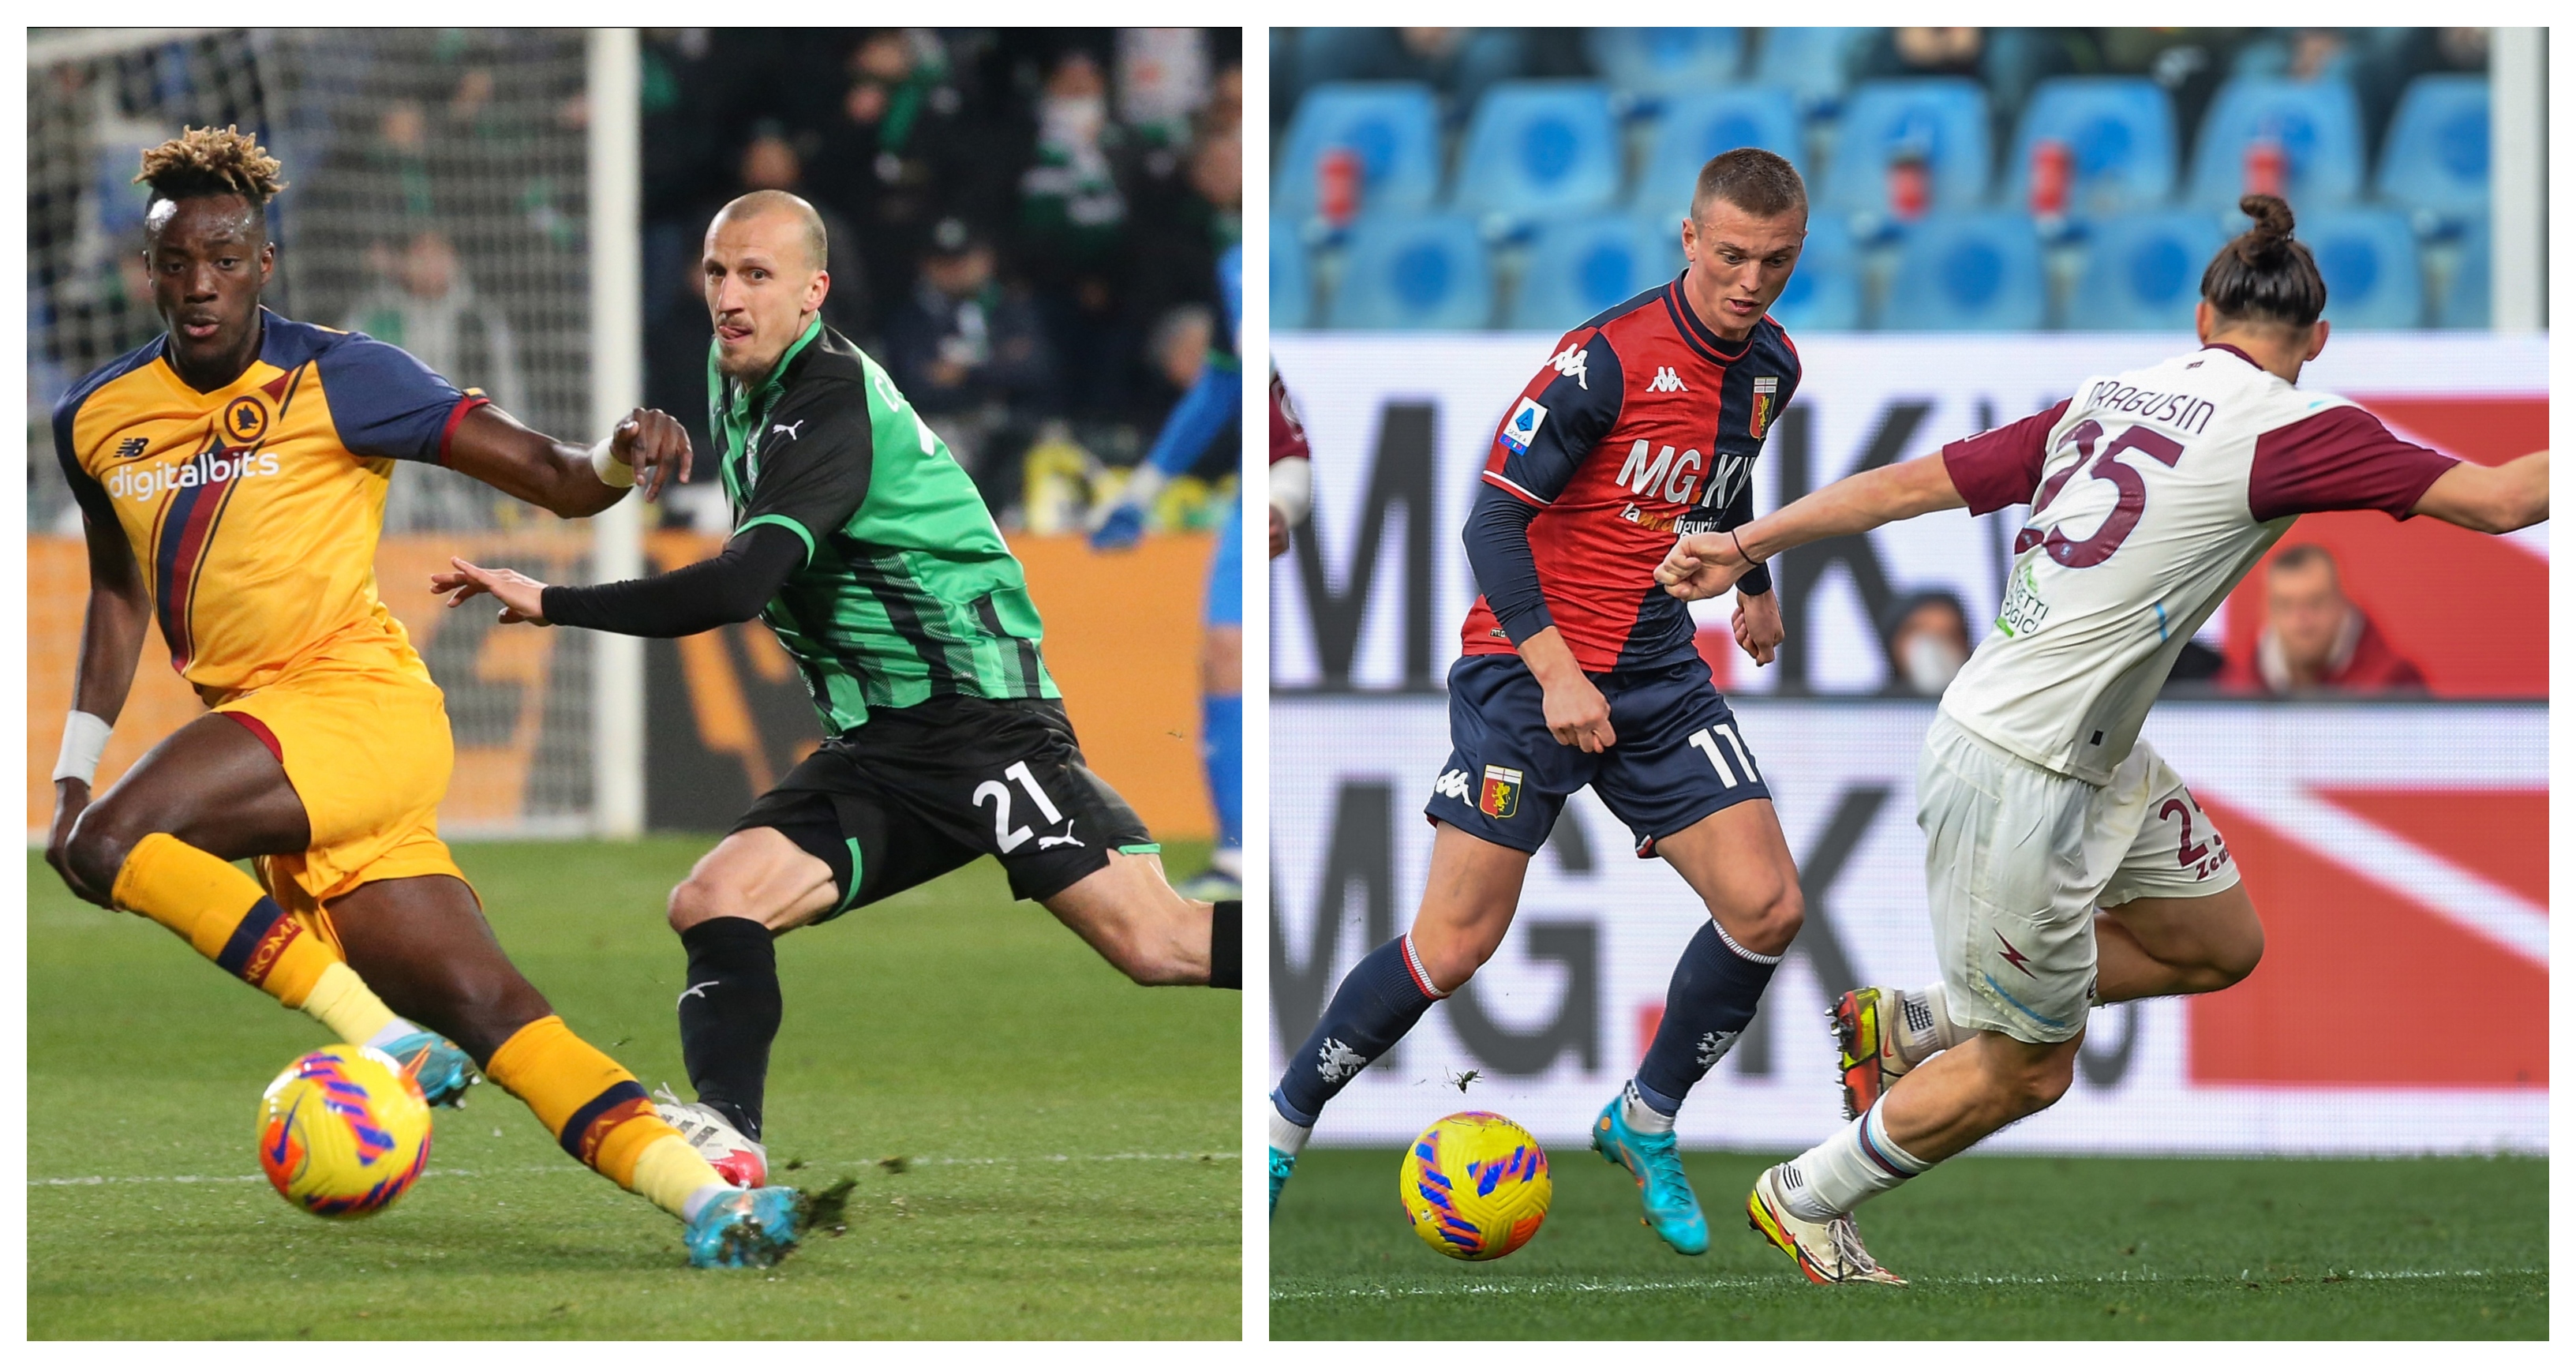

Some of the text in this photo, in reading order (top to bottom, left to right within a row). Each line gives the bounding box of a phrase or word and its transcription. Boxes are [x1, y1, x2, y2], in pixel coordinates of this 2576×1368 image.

[109, 452, 280, 502] digitalbits
[2015, 419, 2185, 568] 25
[1688, 723, 1758, 789] 11
[972, 760, 1063, 853] 21
[2159, 786, 2222, 868] 2
